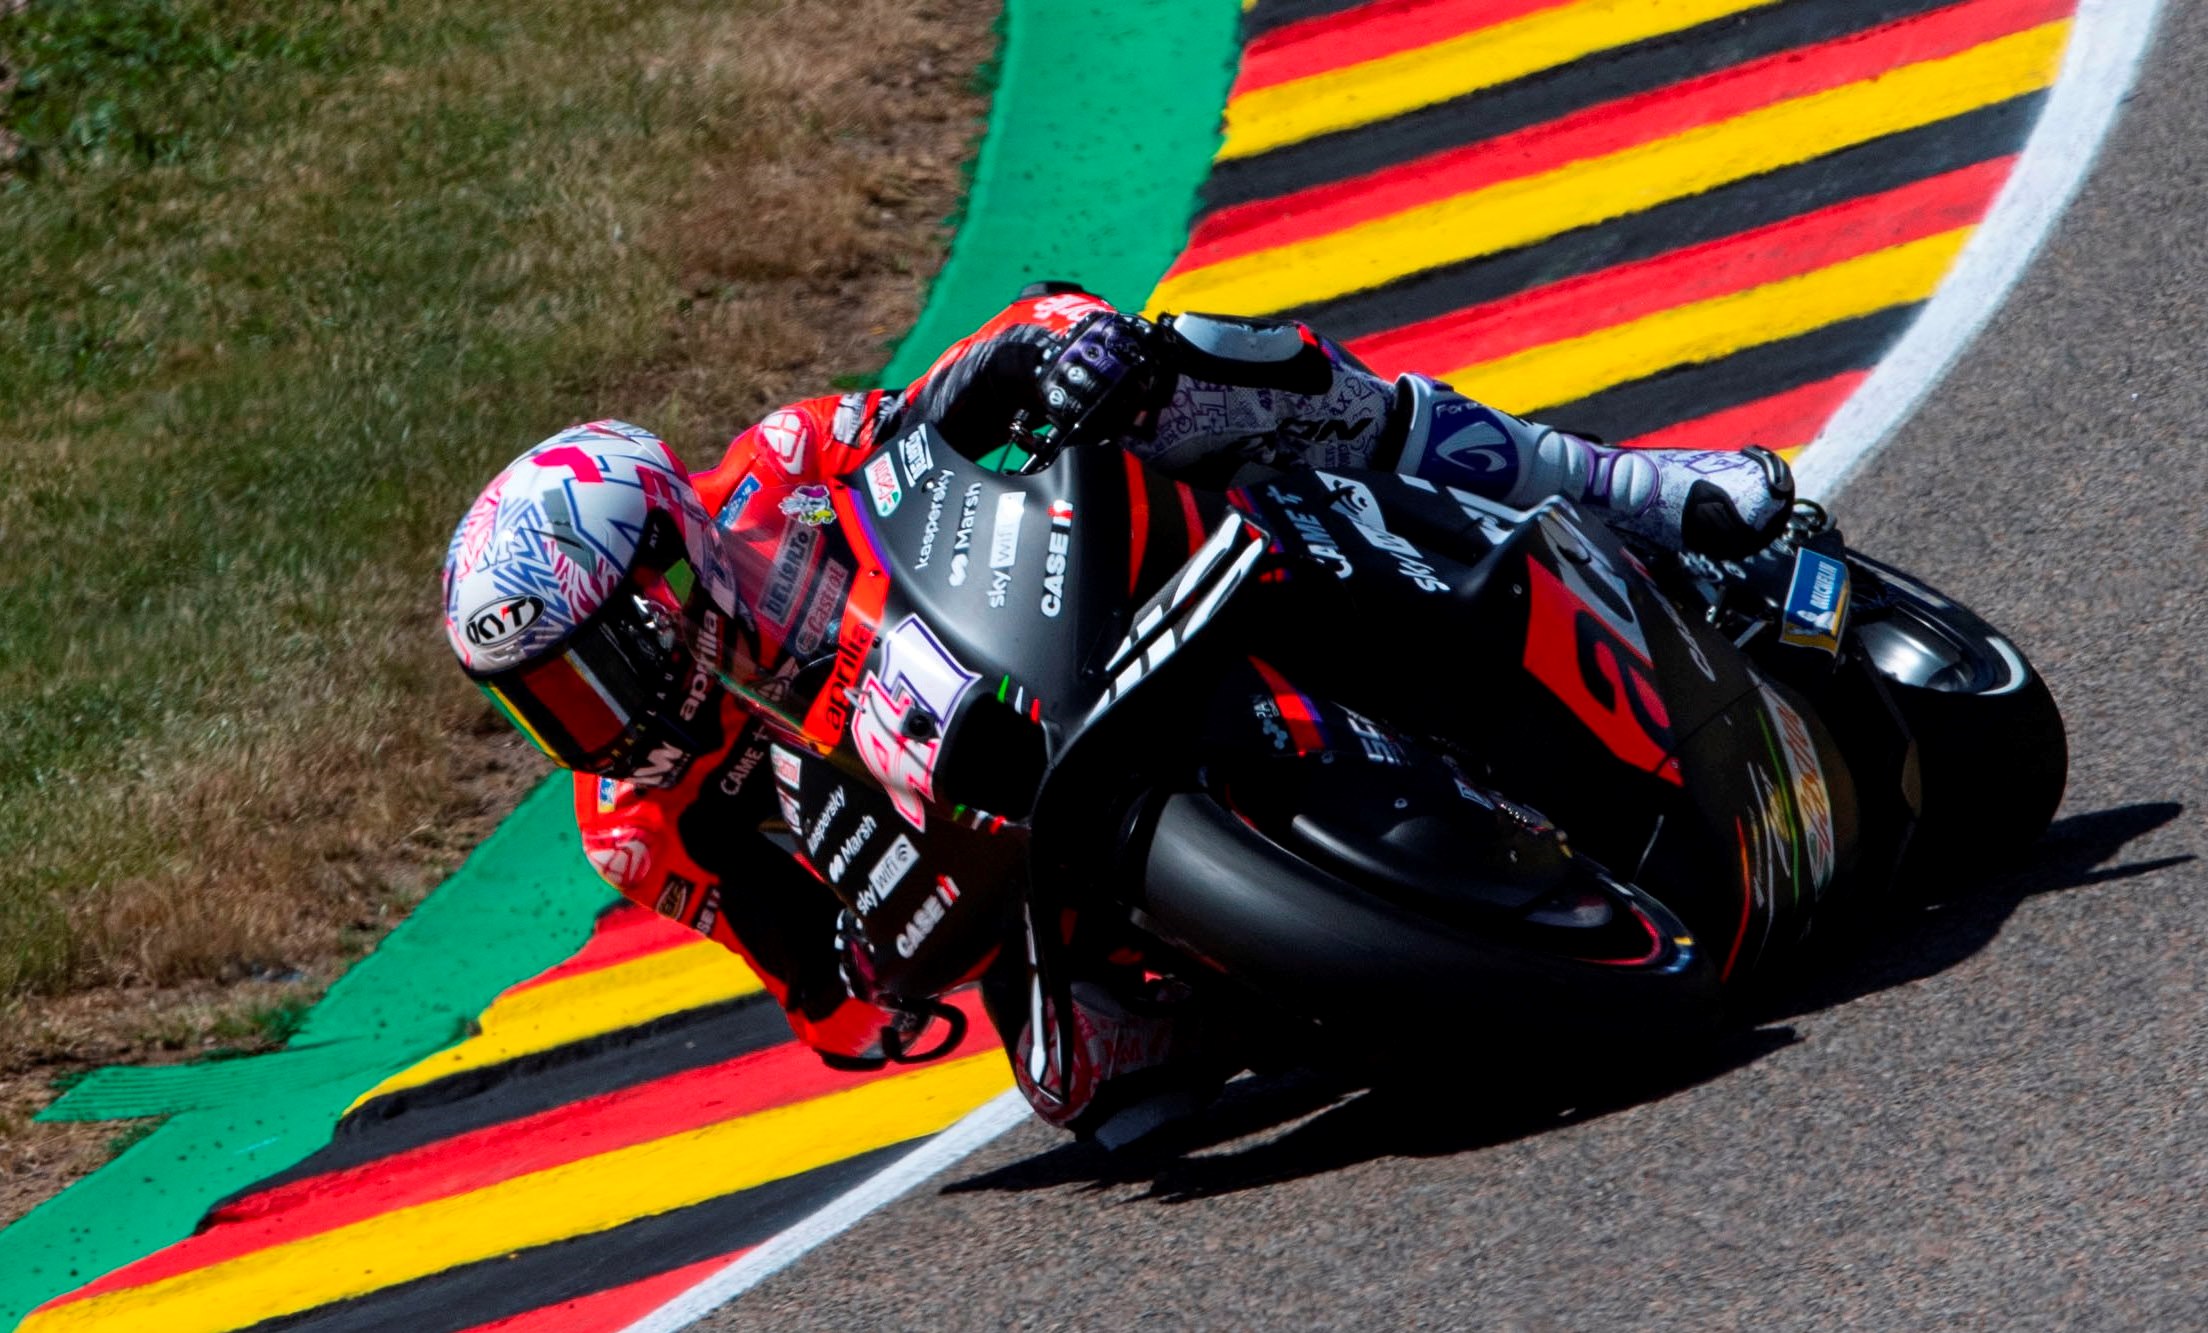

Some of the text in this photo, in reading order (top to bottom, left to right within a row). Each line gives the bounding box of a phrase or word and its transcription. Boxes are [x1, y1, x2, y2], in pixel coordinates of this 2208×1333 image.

[914, 469, 955, 571] kaspersky
[954, 481, 982, 550] Marsh
[807, 565, 845, 635] Castrol
[986, 569, 1011, 608] sky
[1040, 530, 1070, 618] CASE
[1810, 561, 1839, 611] MICHELIN
[467, 597, 529, 645] KYT
[679, 608, 719, 723] aprilia
[825, 623, 874, 731] aprilia
[720, 745, 764, 796] CAME
[839, 813, 878, 861] Marsh
[856, 886, 881, 916] sky
[896, 894, 946, 959] CASE
